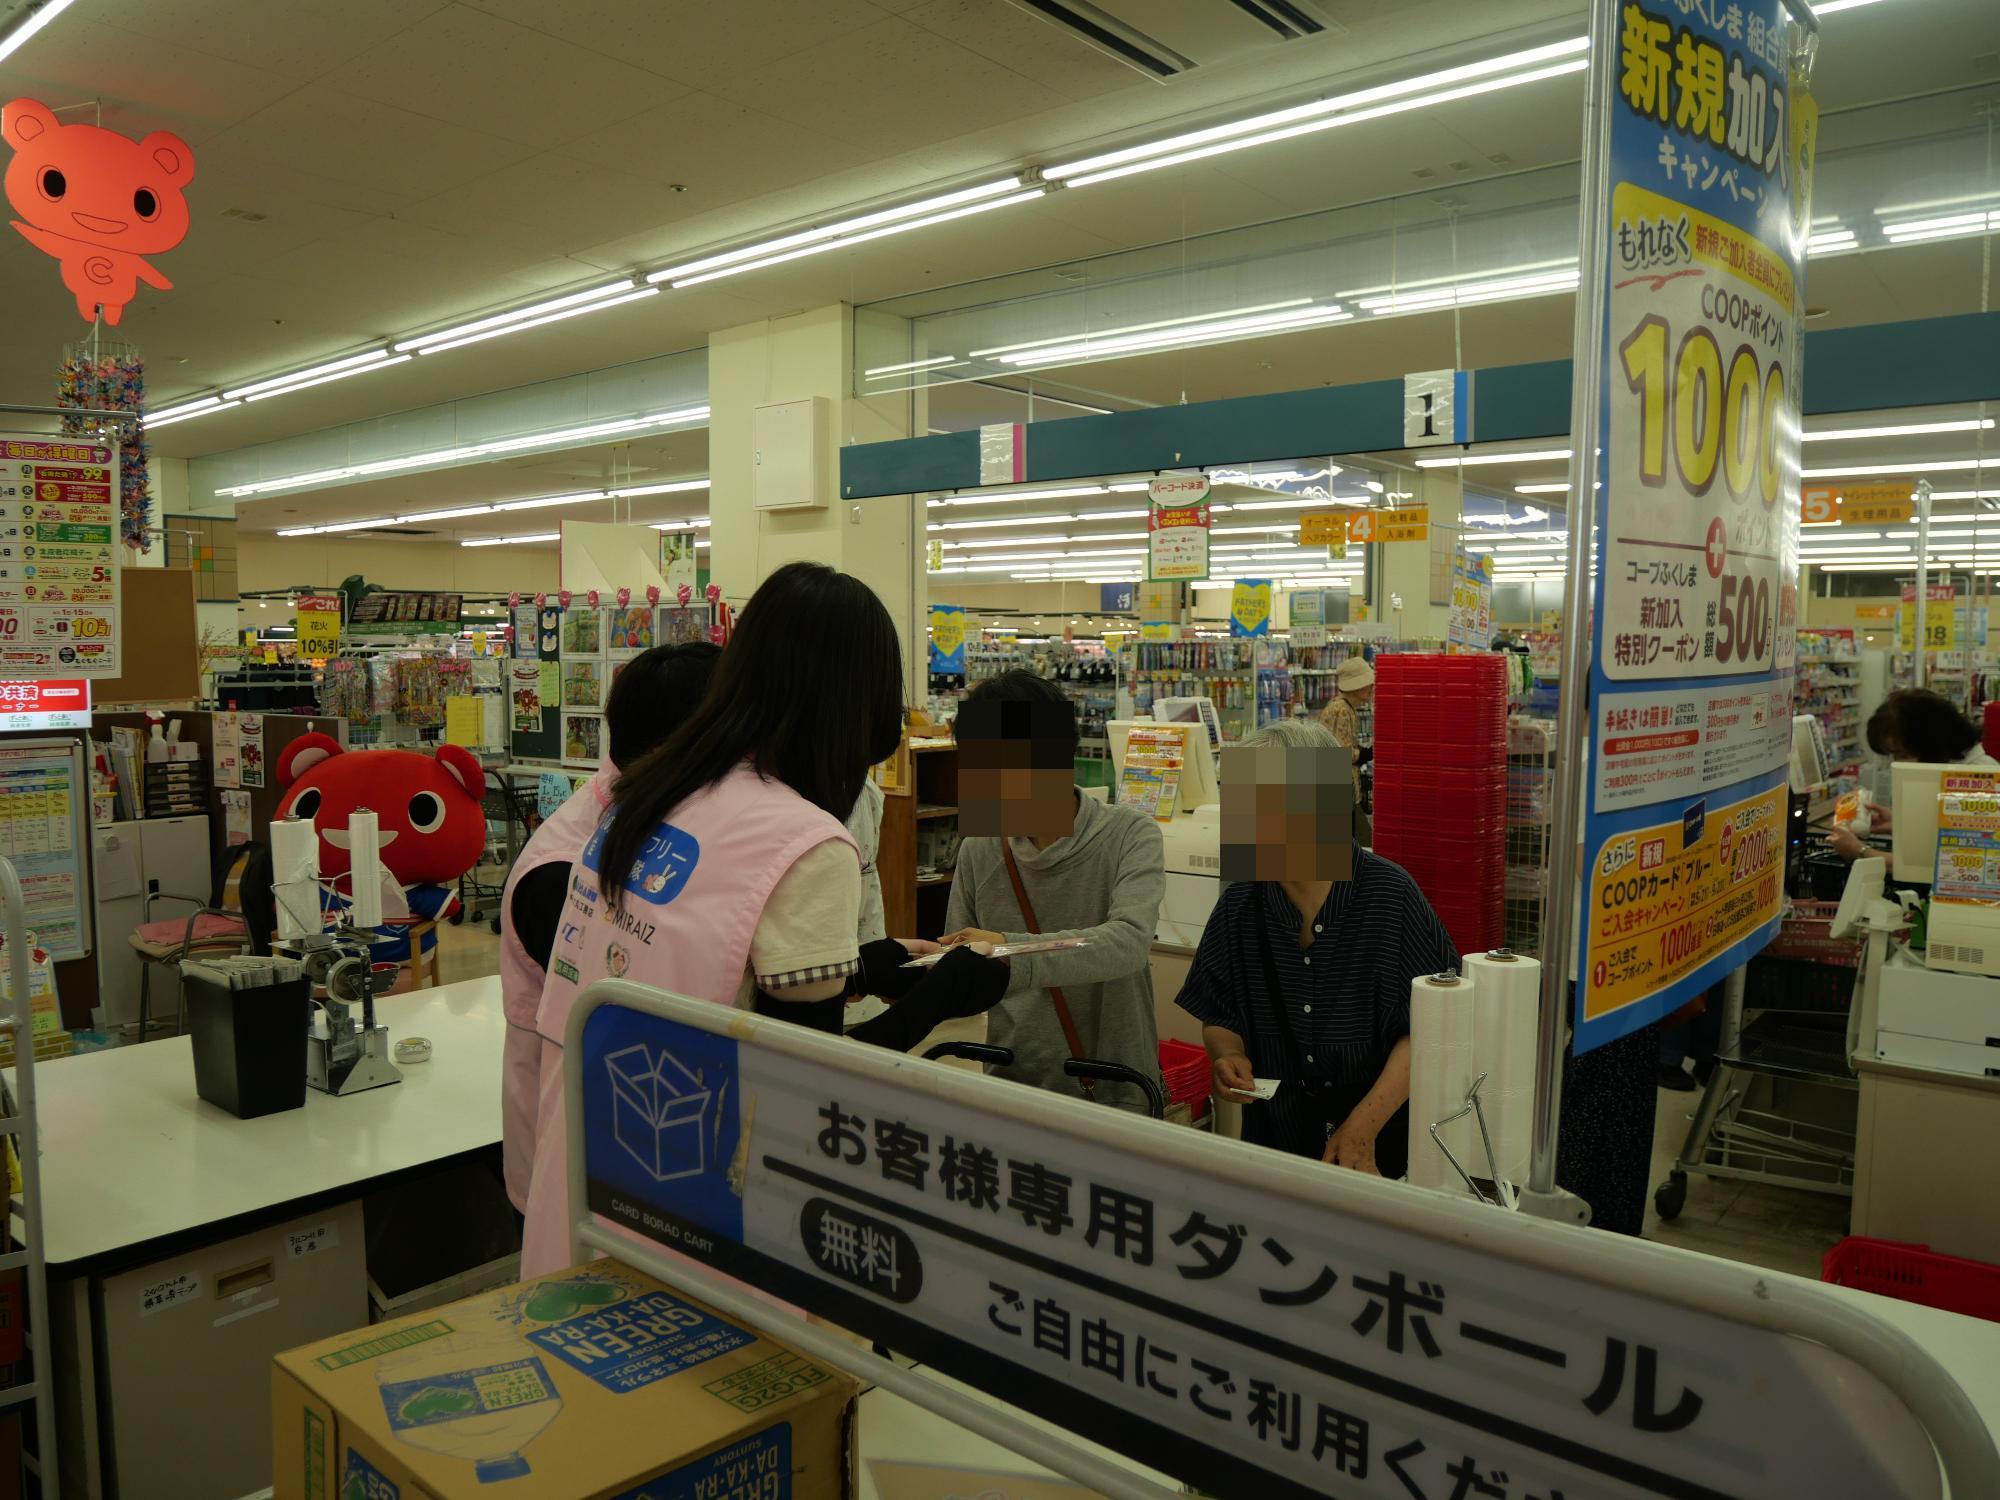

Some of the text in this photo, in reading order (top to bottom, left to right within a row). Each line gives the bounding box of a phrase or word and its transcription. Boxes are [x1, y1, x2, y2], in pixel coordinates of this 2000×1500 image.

[1621, 4, 1788, 190] 新規加入
[1658, 136, 1769, 218] キャンペーン
[1617, 217, 1690, 263] もれなく
[1702, 284, 1784, 352] COOPポイント
[1417, 392, 1440, 438] 1
[1619, 313, 1784, 511] 1000
[7, 442, 90, 461] 毎日が得曜日
[1153, 481, 1204, 494] バーコード決済
[1806, 491, 1830, 521] 5
[1850, 508, 1901, 520] 生理用品
[1352, 515, 1372, 539] 4
[91, 567, 105, 582] 5
[1626, 560, 1697, 588] コープふくしま
[310, 621, 328, 631] 花火
[1640, 596, 1683, 629] 新加入
[1715, 575, 1769, 663] 500
[301, 638, 339, 655] 10%引
[1614, 633, 1700, 667] 特別クーポン
[1606, 706, 1674, 732] 手続きは簡単!
[1602, 838, 1664, 873] さらに 新規
[611, 908, 656, 945] MIRAIZ
[1601, 894, 1685, 937] ご入会キャンペーン
[1608, 959, 1653, 987] コープポイント
[1609, 946, 1637, 968] ご入会で
[611, 1199, 713, 1253] CARD BORAD CART
[817, 1101, 1703, 1433] お客様専用ダンボール
[819, 1209, 902, 1294] 無料
[562, 1308, 703, 1365] GREEN
[987, 1280, 1565, 1500] ご自由にご利用くだ
